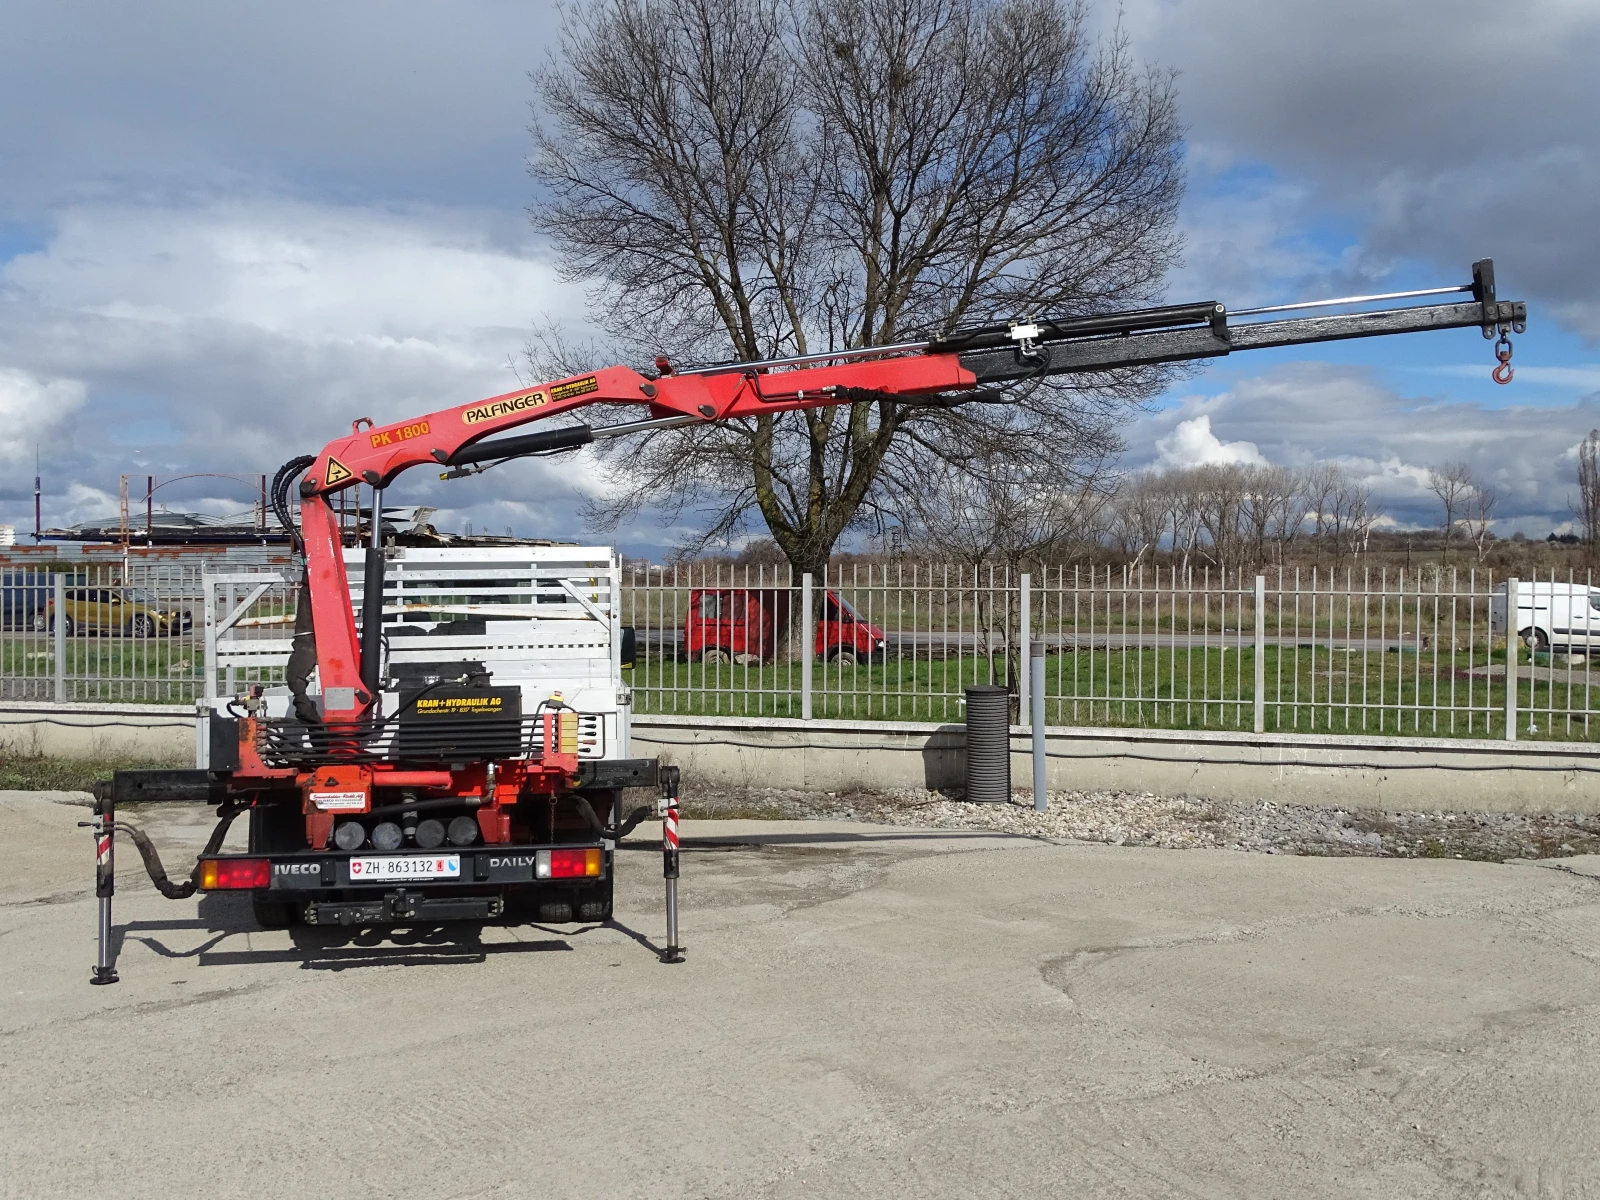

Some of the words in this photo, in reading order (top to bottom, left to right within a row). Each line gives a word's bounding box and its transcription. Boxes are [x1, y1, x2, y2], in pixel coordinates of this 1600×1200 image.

[466, 393, 545, 422] PALFINGER
[371, 431, 392, 448] PK
[395, 421, 429, 441] 1800
[274, 863, 321, 875] IVECO
[365, 861, 380, 874] ZH
[387, 860, 433, 873] 863132
[490, 856, 535, 868] DAILY
